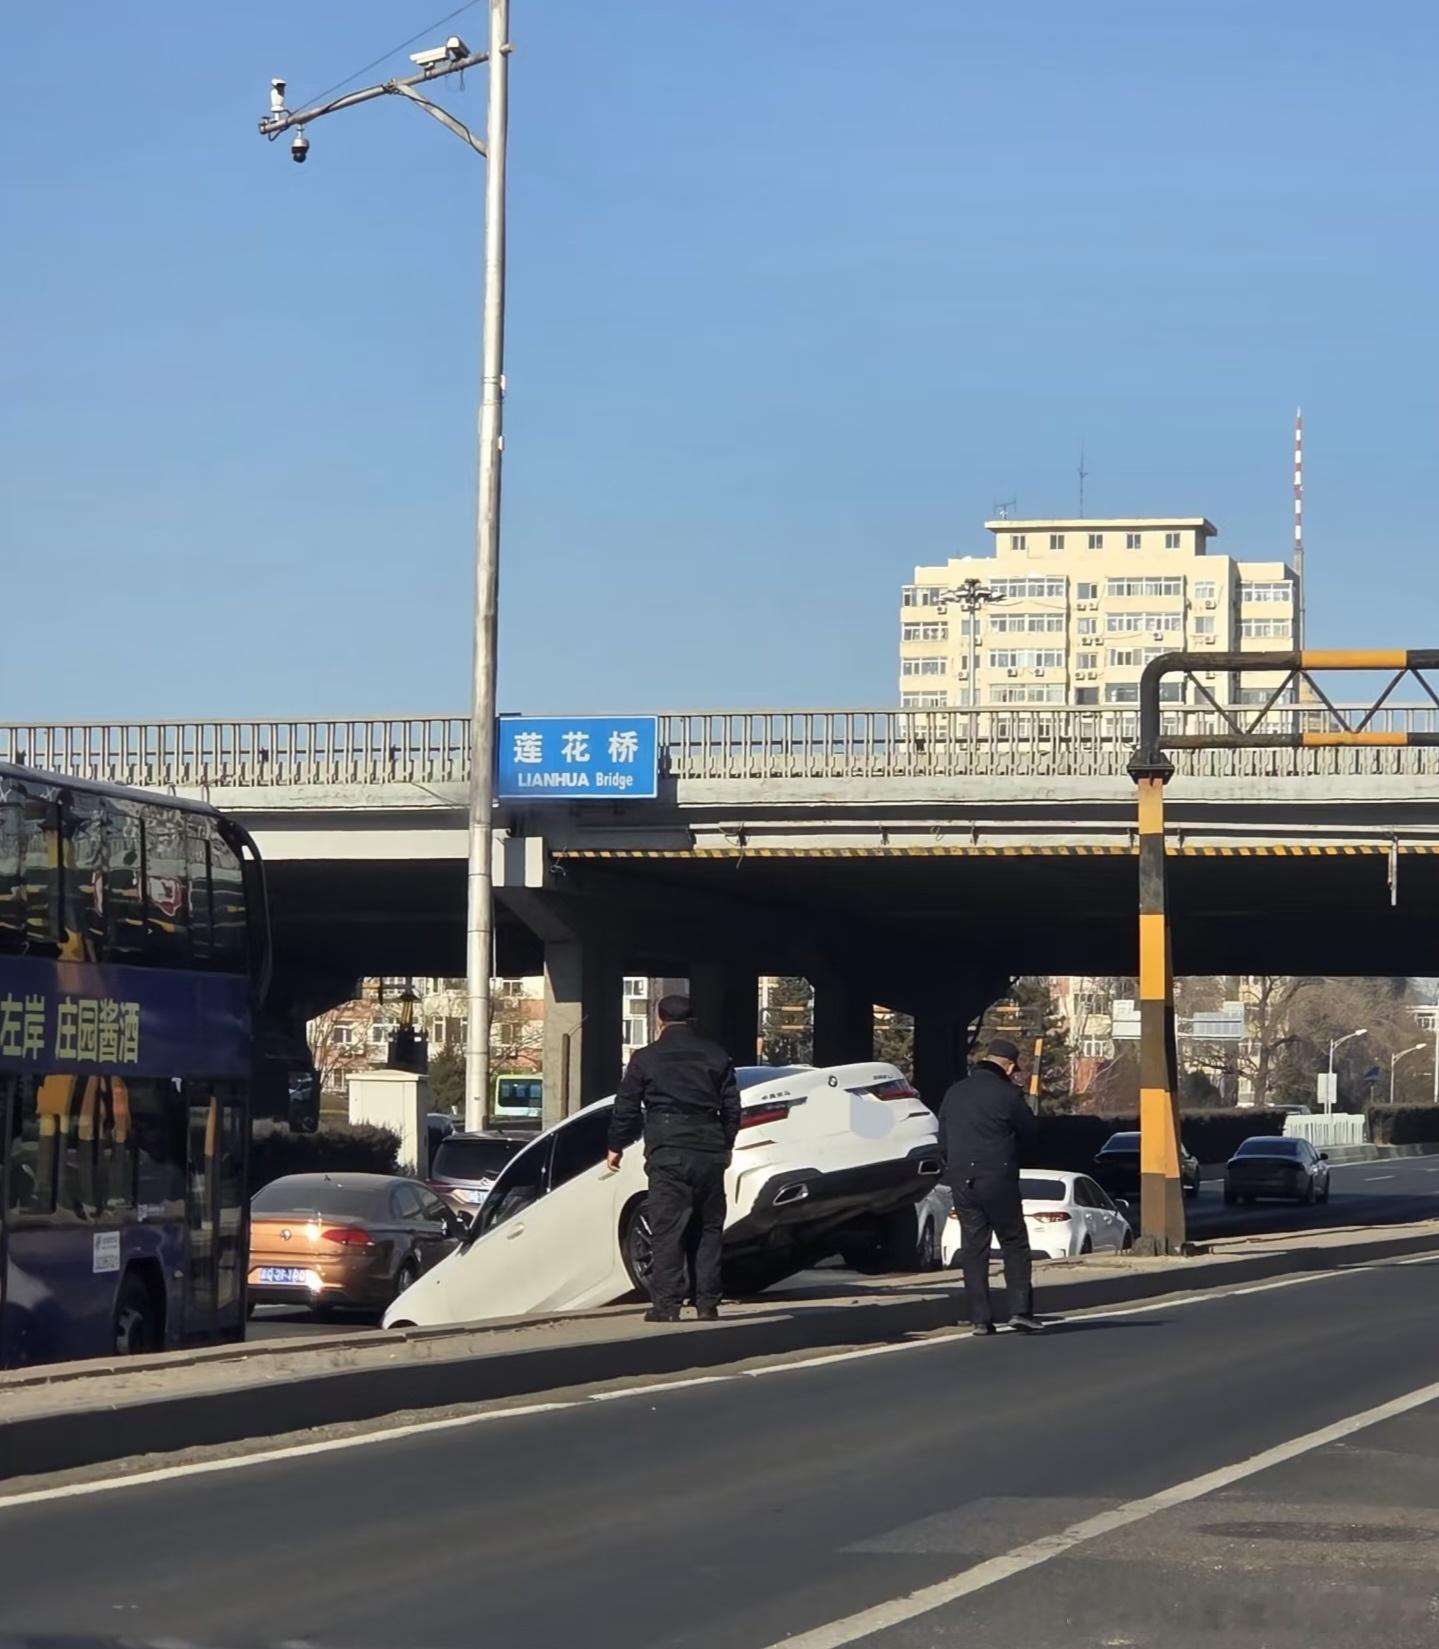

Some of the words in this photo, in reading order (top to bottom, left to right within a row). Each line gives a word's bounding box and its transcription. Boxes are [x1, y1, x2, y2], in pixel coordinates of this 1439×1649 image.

[513, 730, 639, 763] 莲花桥
[518, 772, 590, 787] LIANHUA
[596, 772, 633, 790] Bridge
